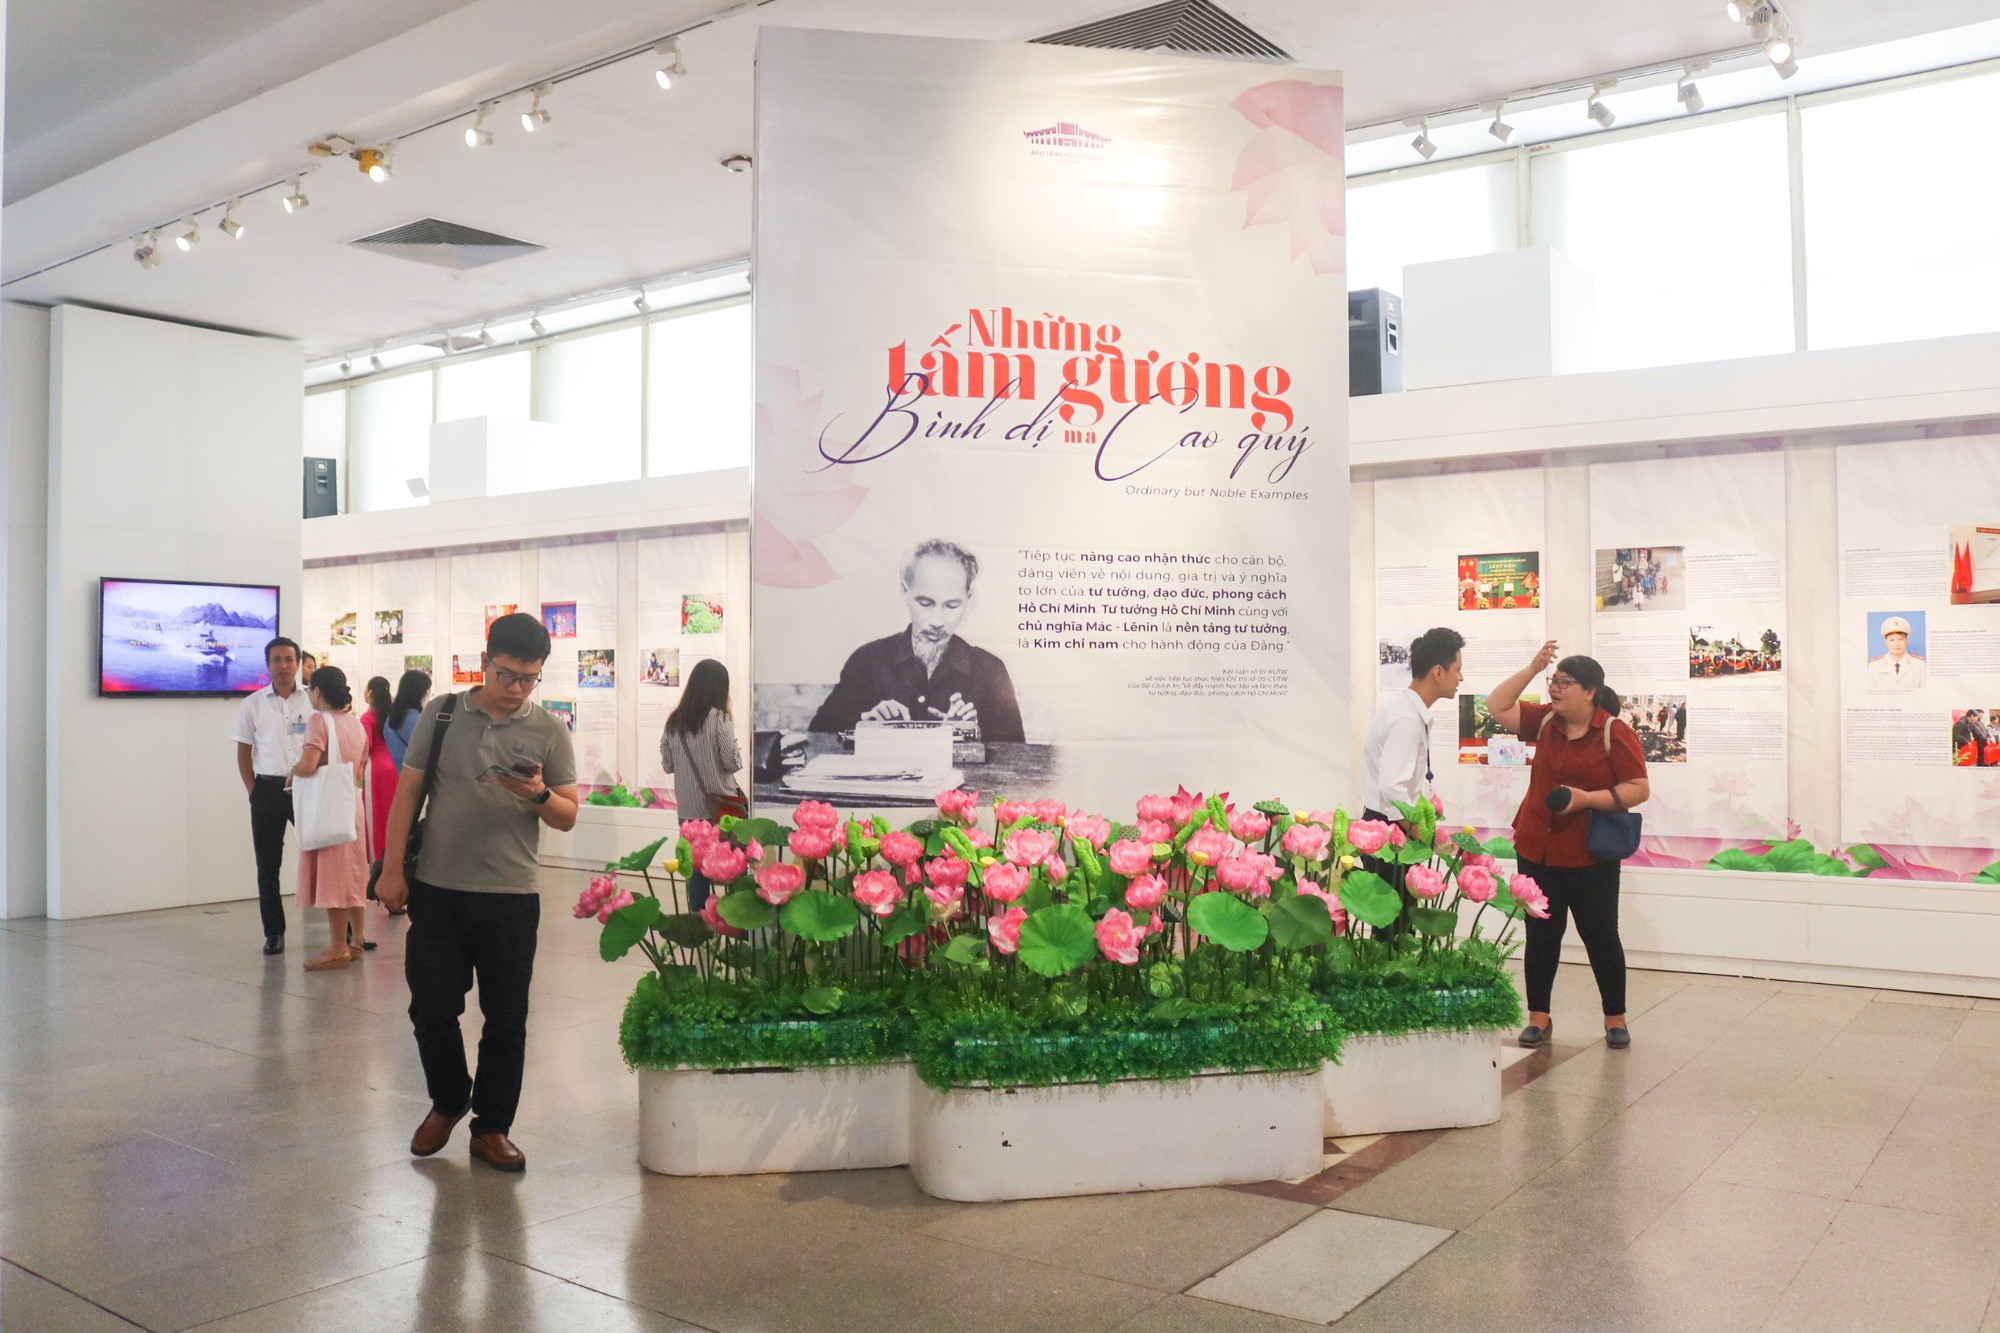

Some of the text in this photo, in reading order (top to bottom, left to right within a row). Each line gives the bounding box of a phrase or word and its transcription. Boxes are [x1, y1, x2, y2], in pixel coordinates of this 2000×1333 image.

[968, 307, 1122, 361] Những
[887, 323, 1295, 434] tấm gương
[803, 372, 1316, 484] Bình dị mà Cao quý
[1125, 485, 1309, 501] Ordinary but Noble Examples
[1055, 552, 1075, 563] tục
[1080, 552, 1114, 564] nâng
[1118, 554, 1140, 562] cao
[1144, 553, 1178, 566] nhận
[1181, 554, 1210, 564] thức
[1214, 555, 1238, 565] cho
[1058, 568, 1086, 579] viên
[1110, 570, 1132, 581] nội
[1136, 570, 1174, 583] dung,
[1204, 572, 1216, 583] trị
[1221, 572, 1235, 582] và
[1240, 572, 1246, 584] ý
[1251, 572, 1287, 584] nghĩa
[1018, 586, 1287, 601] to lớn của tư tưởng, đạo đức, phong cách
[1018, 602, 1036, 613] Hồ
[1040, 603, 1060, 613] Chí
[1102, 604, 1118, 614] Tư
[1120, 604, 1158, 616] tưởng
[1161, 604, 1178, 615] Hồ
[1181, 605, 1202, 616] Chí
[1204, 606, 1235, 616] Minh
[1238, 606, 1268, 618] cùng
[1271, 606, 1288, 616] với
[1018, 620, 1042, 631] chủ
[1046, 622, 1082, 633] nghĩa
[1086, 622, 1112, 632] Mác
[1124, 622, 1158, 632] Lênin
[1162, 622, 1172, 632] là
[1176, 621, 1200, 632] nền
[1203, 622, 1231, 635] tảng
[1234, 624, 1248, 634] tư
[1018, 638, 1029, 648] là
[1034, 638, 1060, 648] Kim
[1122, 640, 1146, 649] cho
[1151, 640, 1183, 650] hành
[1187, 640, 1220, 652] động
[1224, 640, 1246, 650] của
